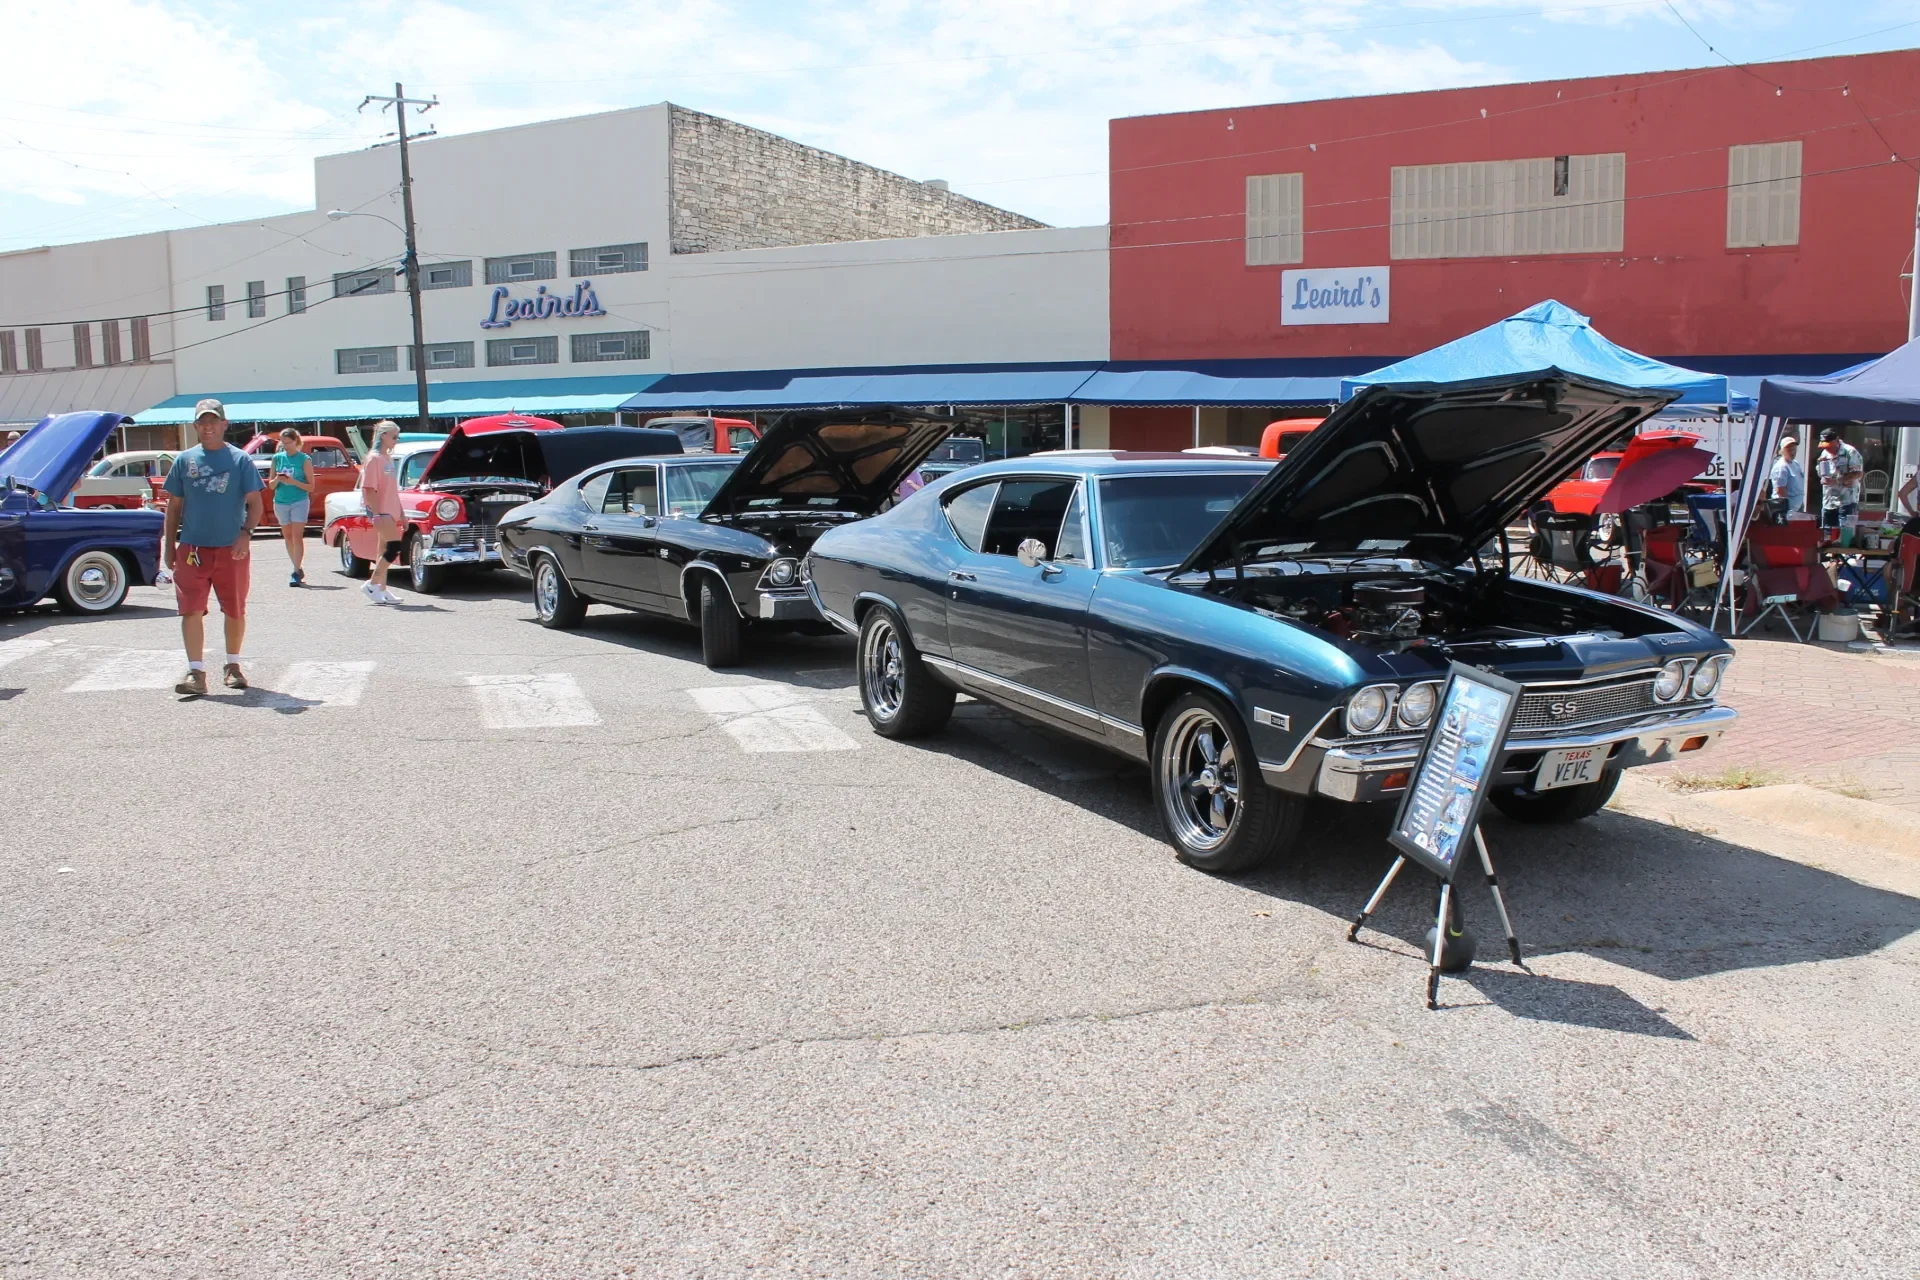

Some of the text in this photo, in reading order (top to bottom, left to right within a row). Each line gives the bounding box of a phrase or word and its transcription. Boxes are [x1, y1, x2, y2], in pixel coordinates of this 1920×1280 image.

[480, 280, 607, 329] Leaird's
[1291, 276, 1381, 310] Leaird's
[1551, 701, 1577, 715] SS
[1565, 750, 1592, 761] TEXAS
